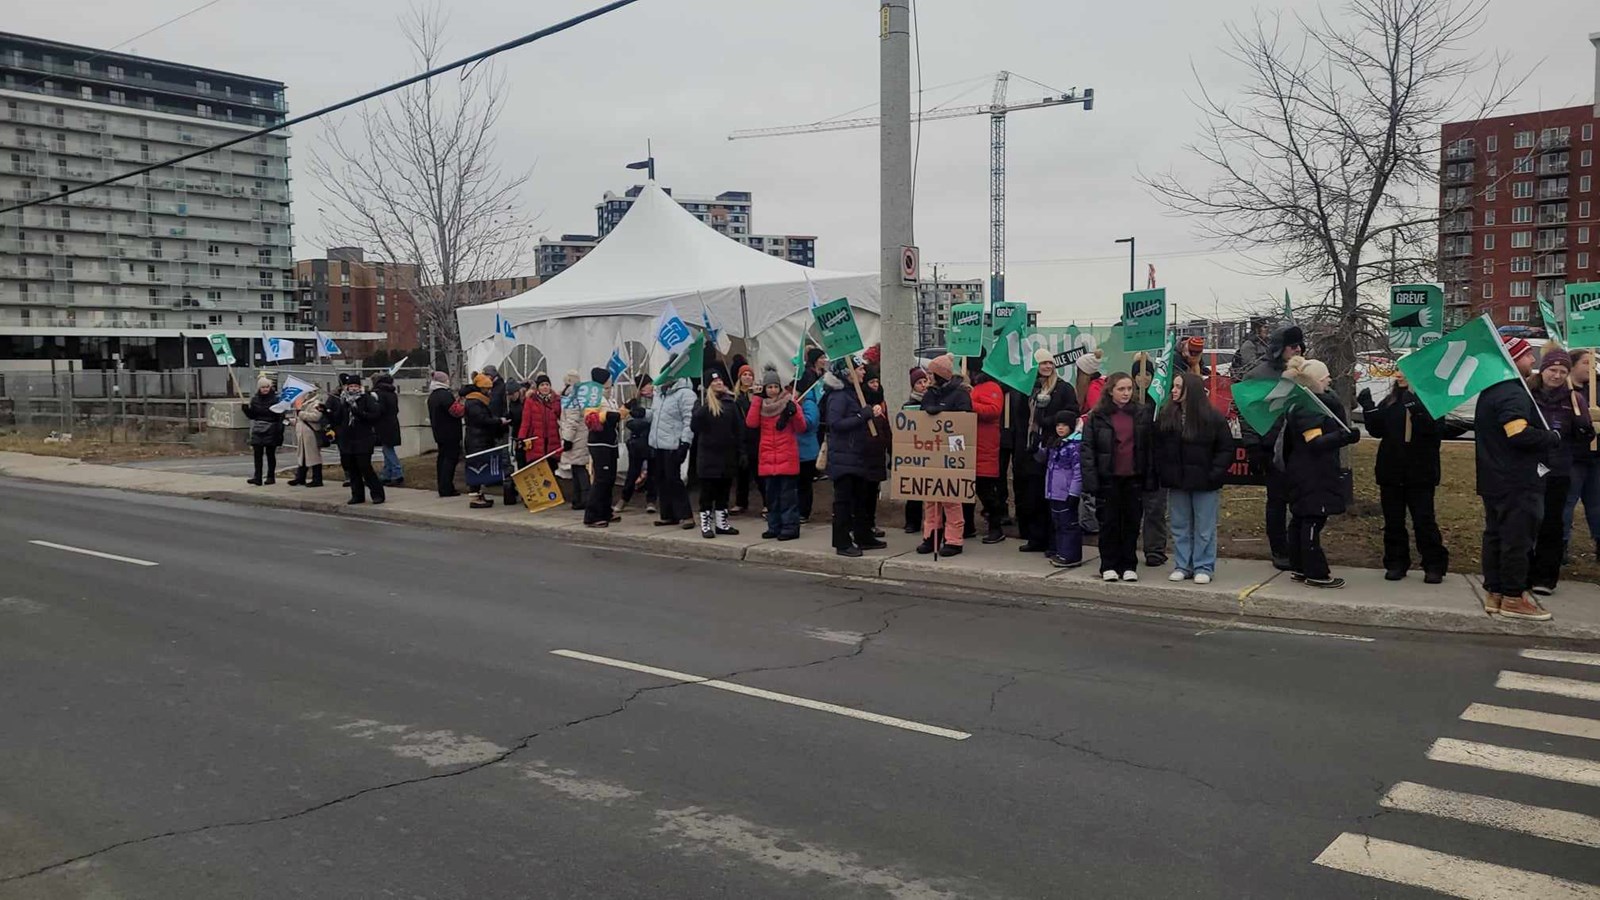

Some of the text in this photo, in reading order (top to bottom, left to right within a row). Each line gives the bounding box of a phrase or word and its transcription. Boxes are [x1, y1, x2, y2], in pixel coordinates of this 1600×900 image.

[1396, 291, 1425, 304] GRÈVE
[1570, 293, 1600, 312] NOU
[997, 307, 1014, 317] GRÈV
[1126, 299, 1162, 319] NOUS
[817, 307, 851, 331] NOUS
[953, 311, 980, 326] NOUS
[1054, 353, 1068, 367] ULE
[896, 412, 954, 433] On se
[914, 434, 942, 451] bat
[895, 455, 965, 471] pour les
[900, 476, 976, 498] ENFANTS
